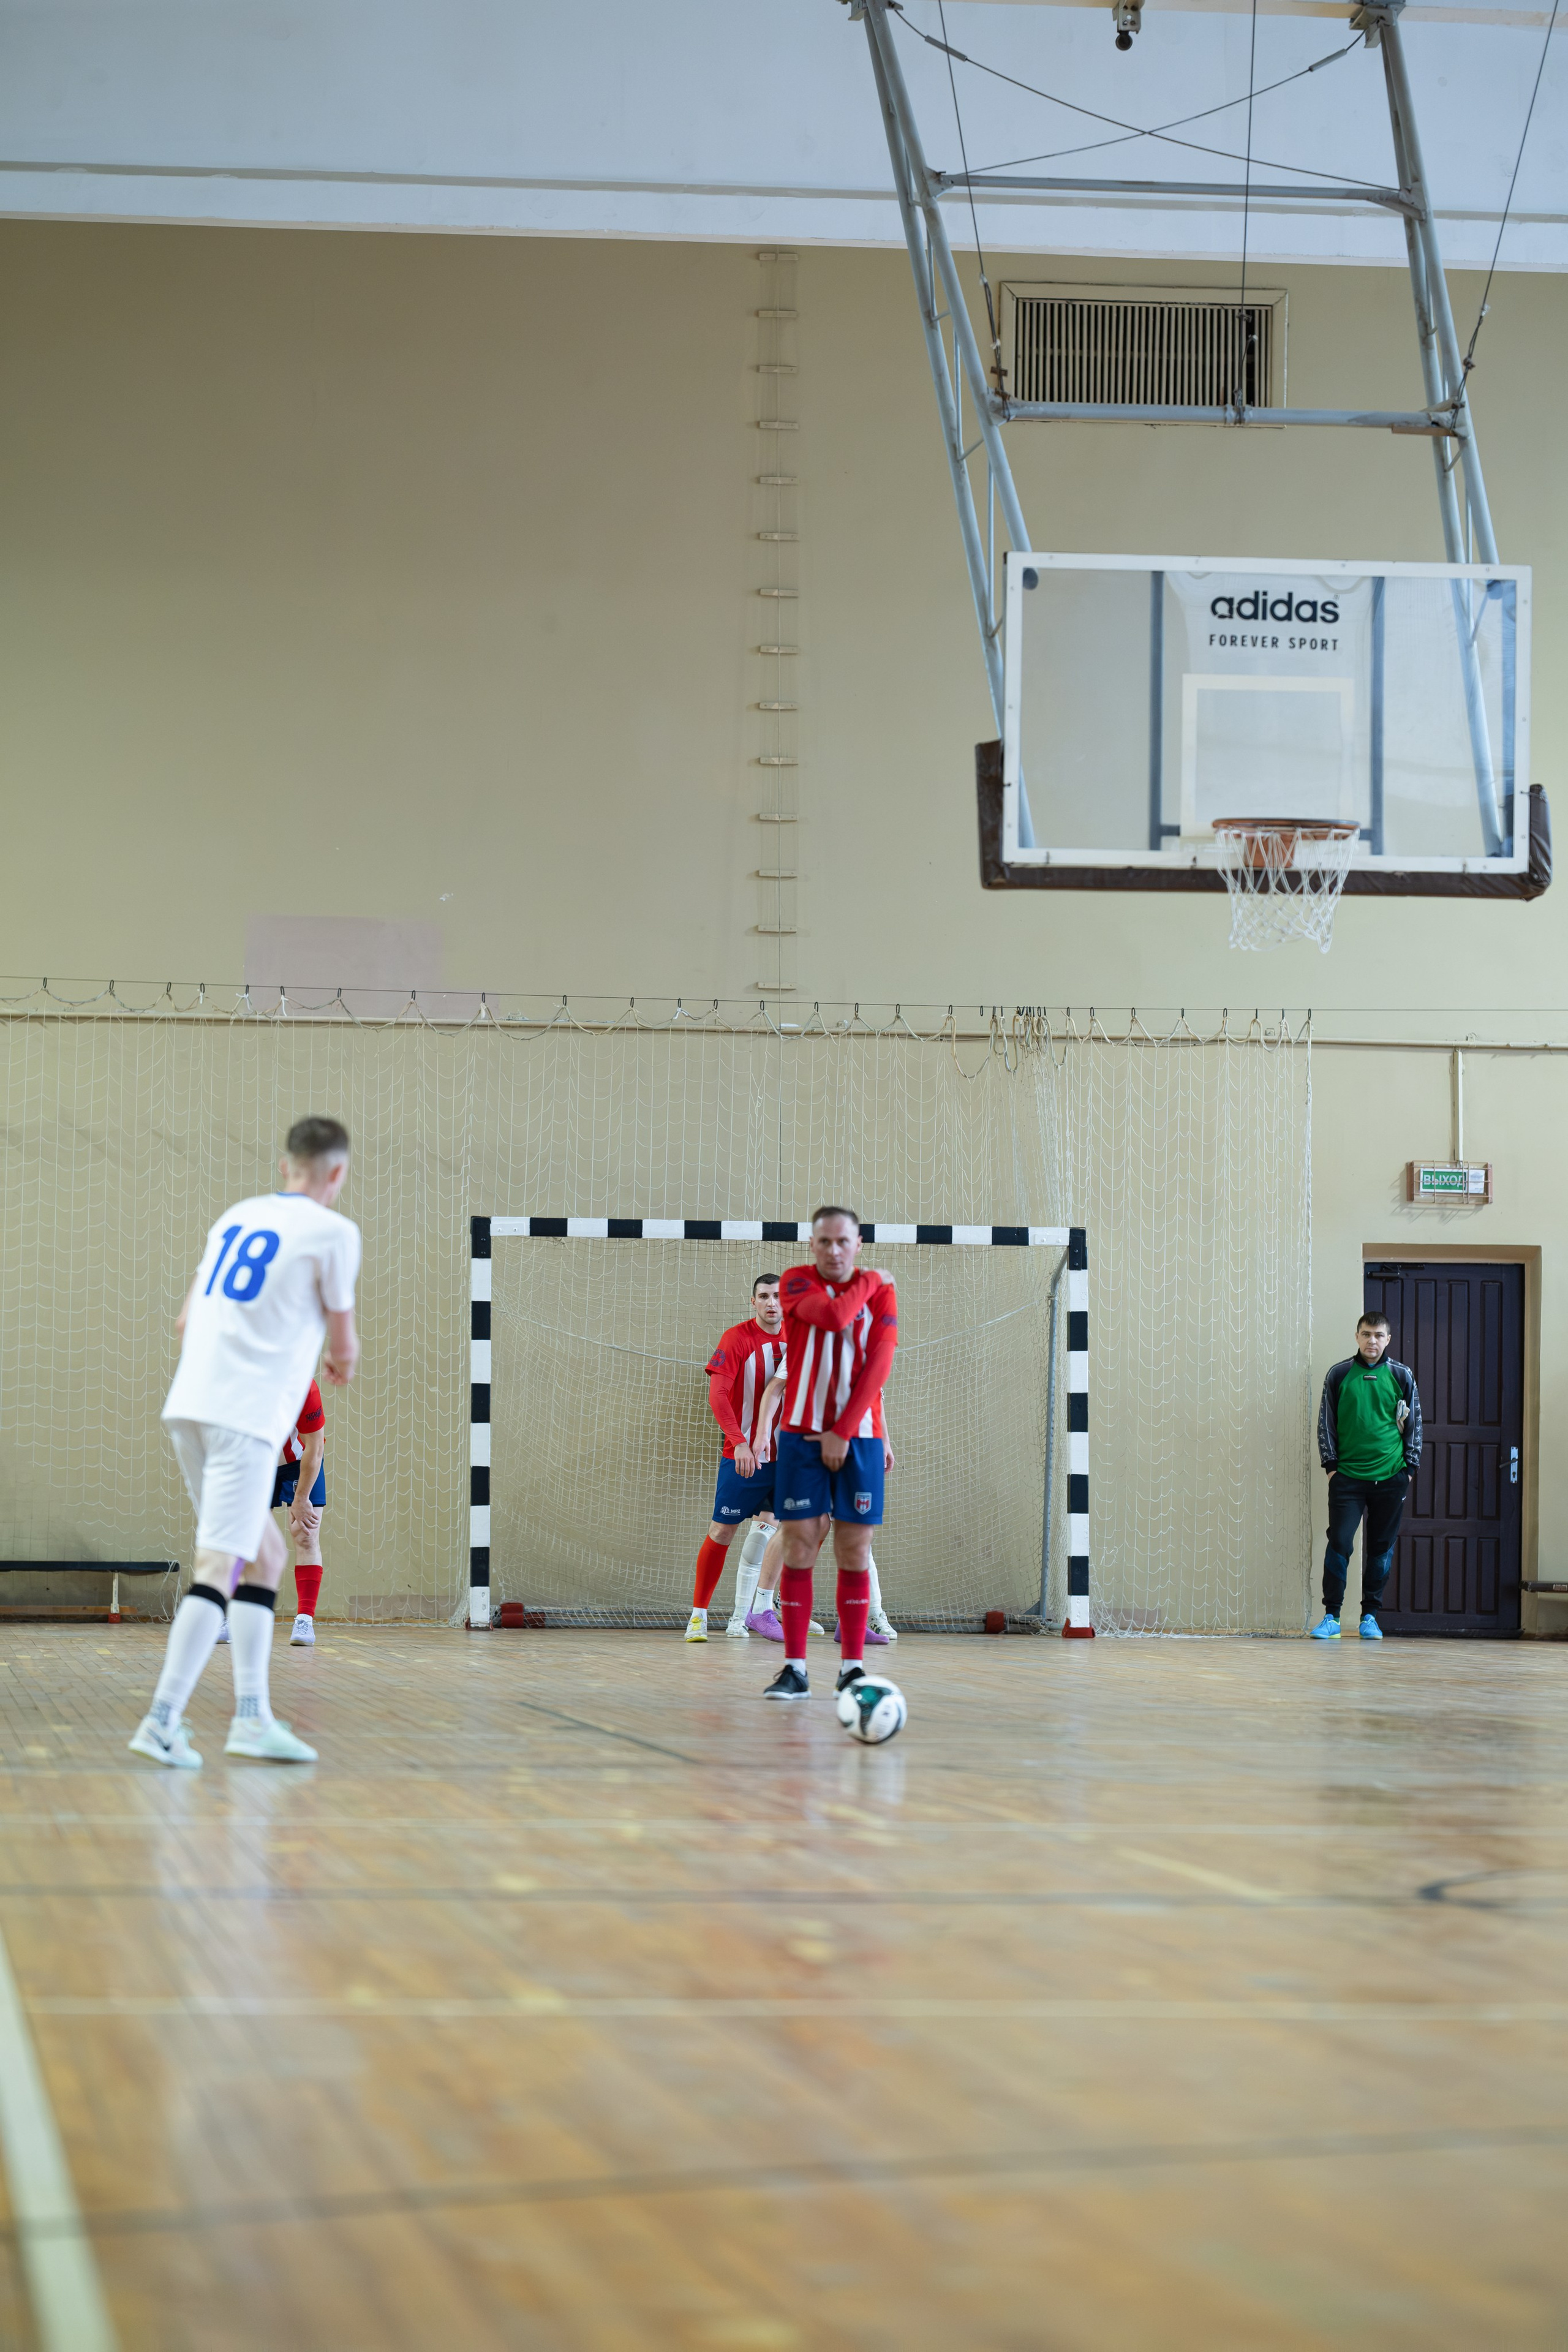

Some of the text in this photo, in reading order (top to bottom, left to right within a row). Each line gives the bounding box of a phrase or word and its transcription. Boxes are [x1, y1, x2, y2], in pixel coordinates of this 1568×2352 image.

[1211, 590, 1340, 624] adidas
[1209, 634, 1338, 650] FOREVER SPORT
[1423, 1174, 1465, 1187] ВЫХОД
[205, 1226, 279, 1301] 18
